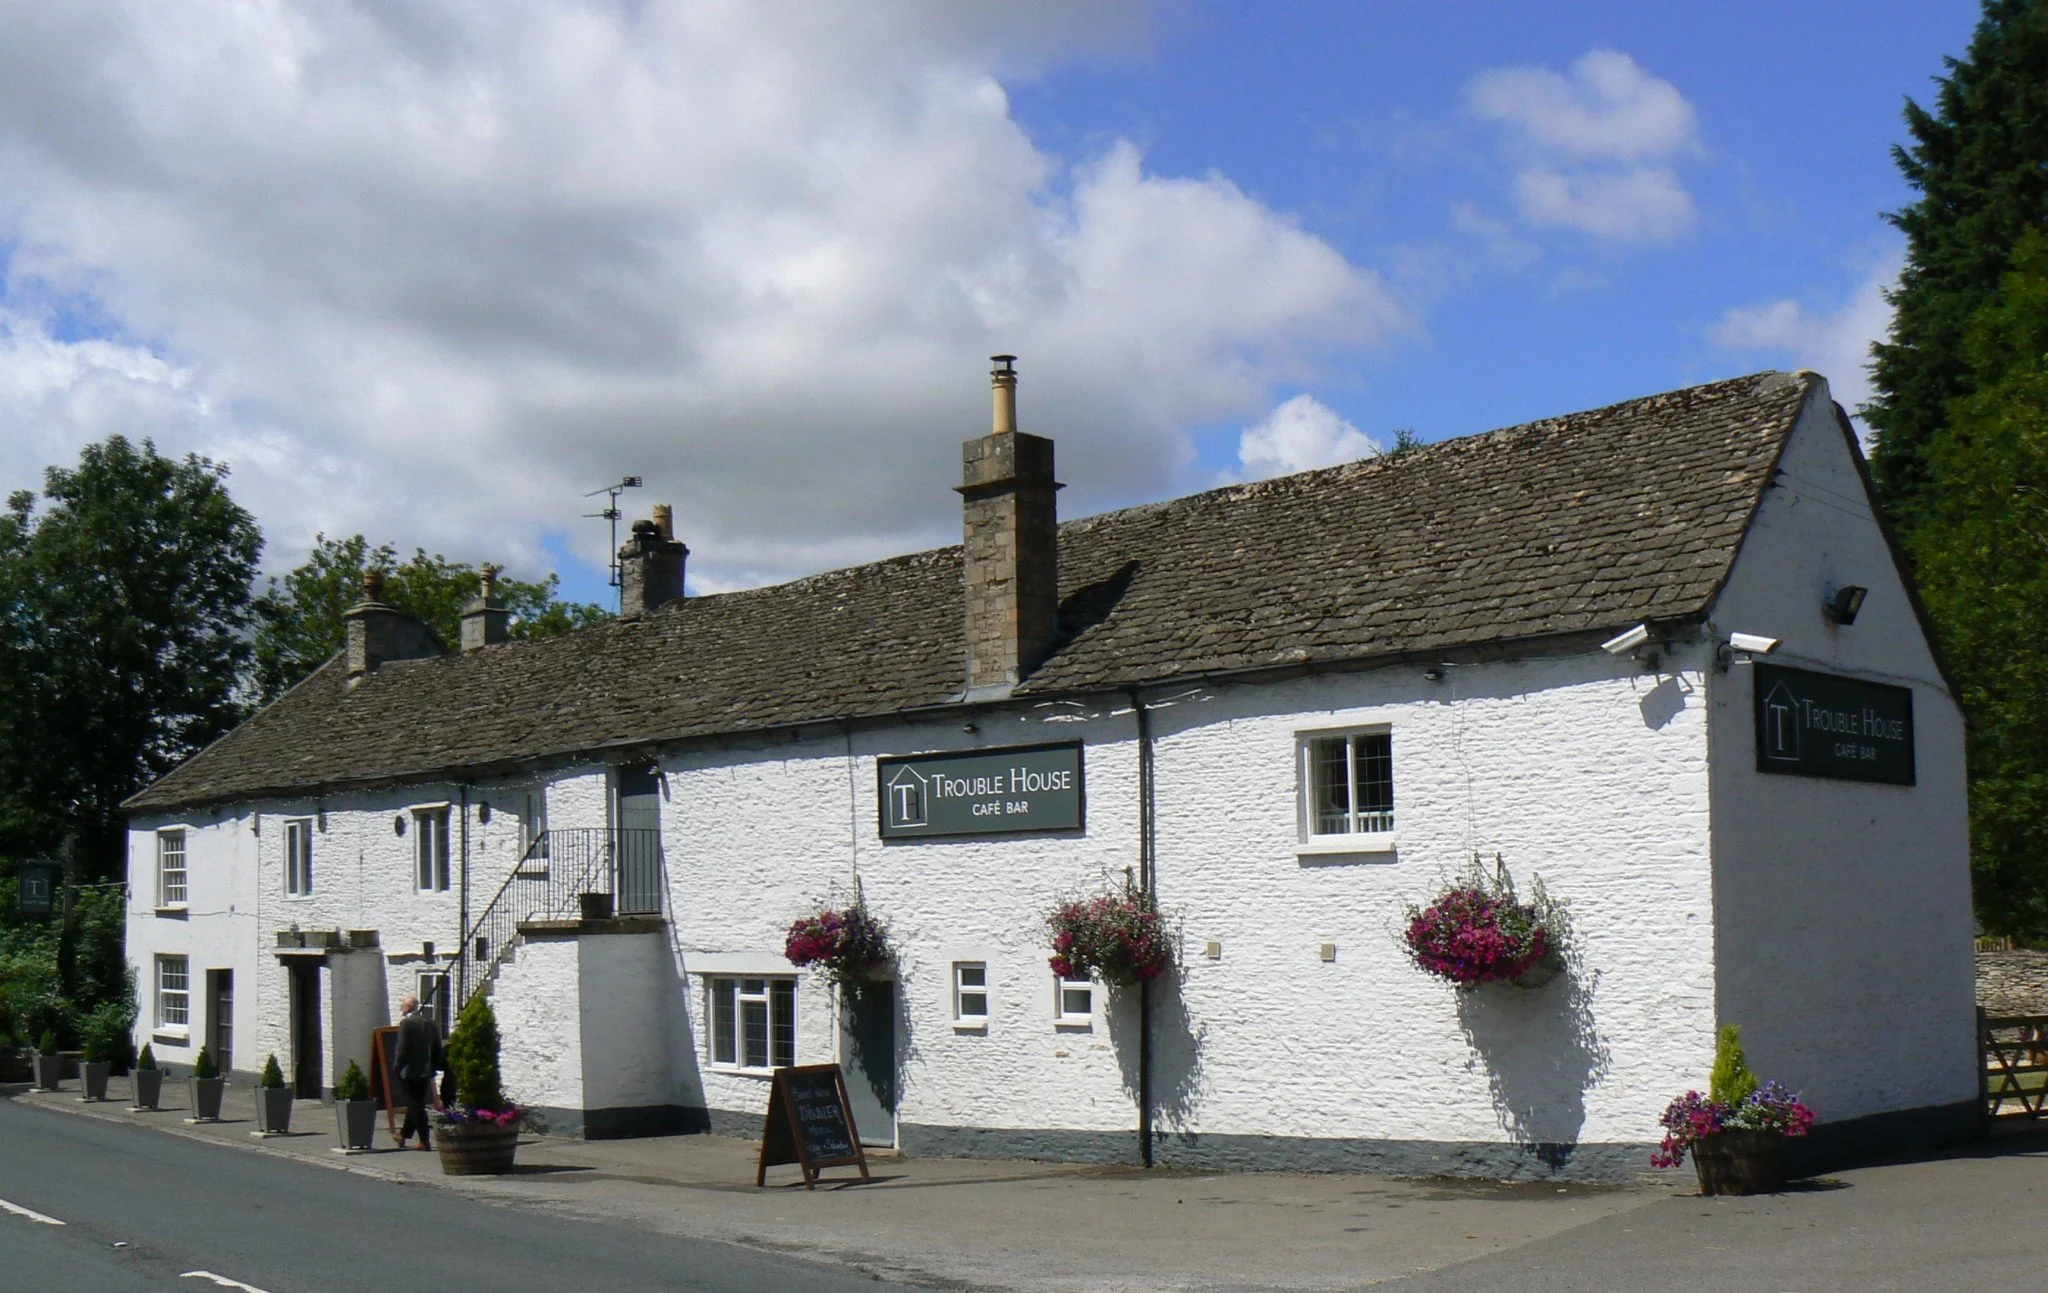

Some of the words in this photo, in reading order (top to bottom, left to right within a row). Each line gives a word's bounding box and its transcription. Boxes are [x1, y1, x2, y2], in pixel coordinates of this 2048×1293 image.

[1802, 698, 1859, 735] TROUBLE
[1862, 708, 1904, 741] HOUSE
[1860, 747, 1876, 760] BAR
[931, 773, 1004, 798] TROUBLE
[1010, 767, 1072, 793] HOUSE
[972, 800, 1001, 816] CAFÉ
[1006, 801, 1029, 814] BAR
